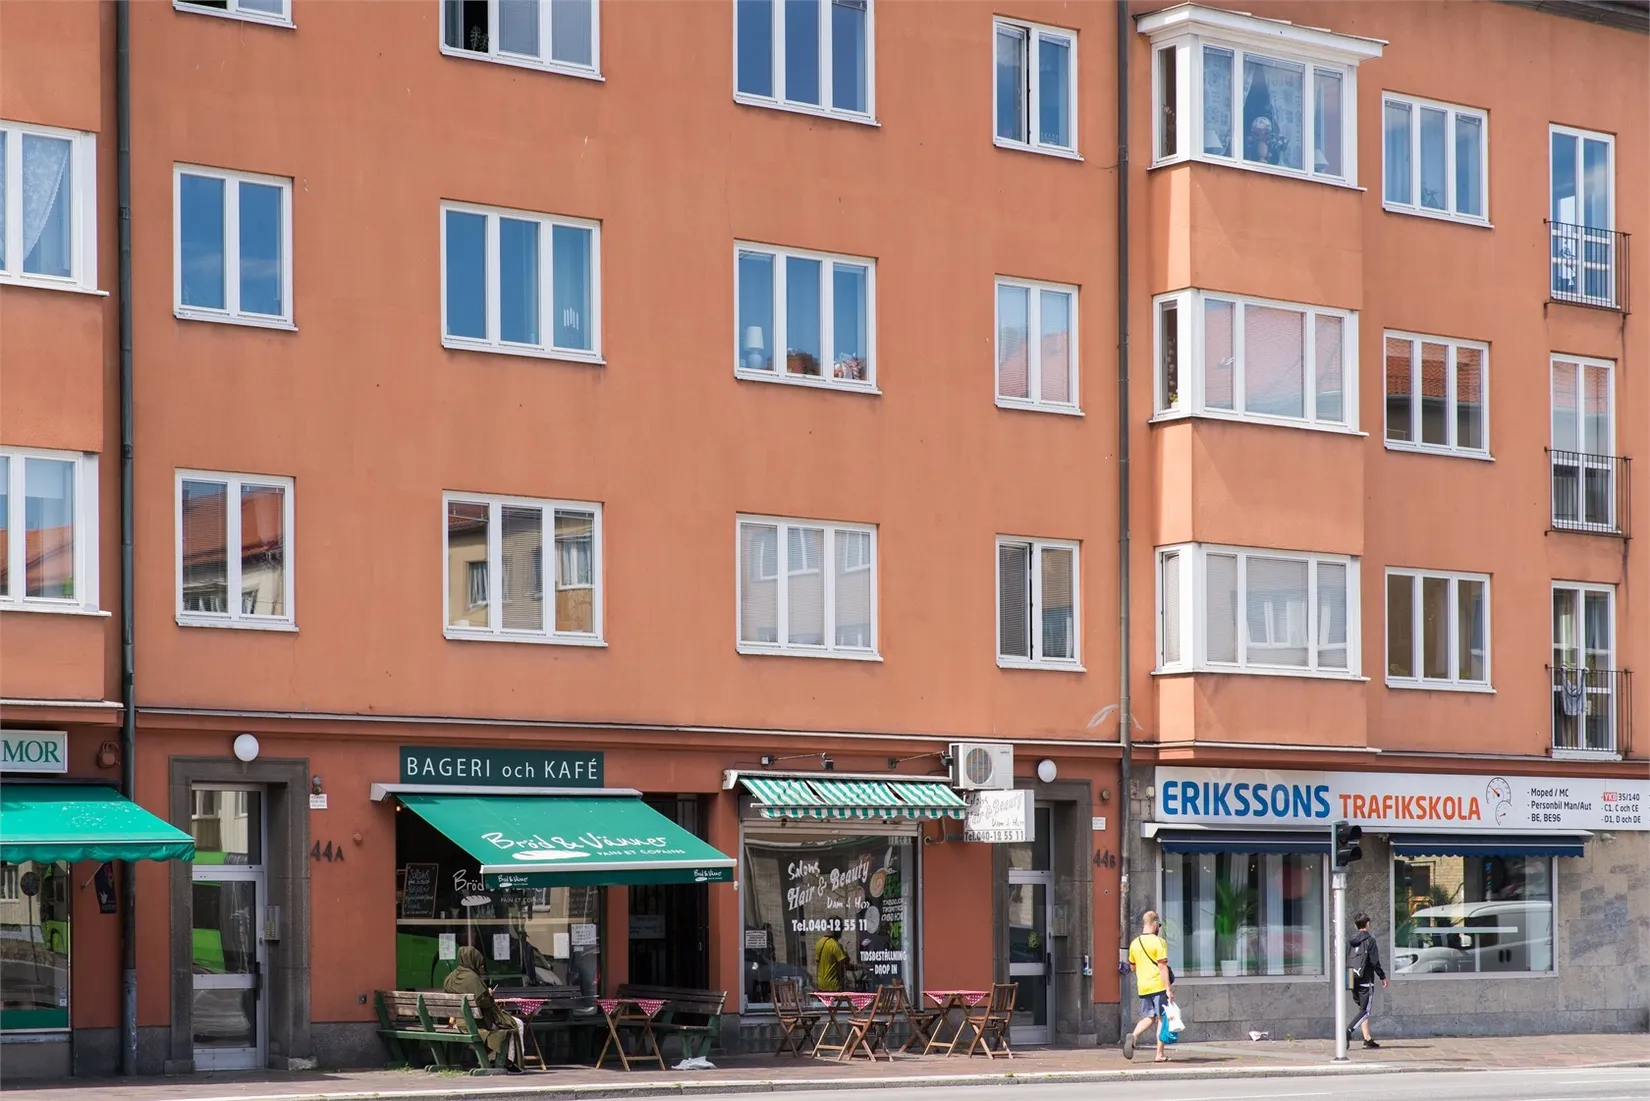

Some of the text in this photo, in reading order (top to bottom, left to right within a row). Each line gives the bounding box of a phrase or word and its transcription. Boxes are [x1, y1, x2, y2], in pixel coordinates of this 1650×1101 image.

[2, 740, 61, 763] MOR
[407, 757, 597, 780] BAGERI och KAFÉ
[1162, 780, 1482, 821] ERIKSSONS TRAFIKSKOLA
[1530, 788, 1553, 798] Moped
[1560, 789, 1569, 797] MC
[1618, 793, 1640, 801] 35/140
[993, 793, 1023, 815] Beauty
[1531, 801, 1591, 811] Personbil Man/Aut
[1620, 804, 1630, 812] och
[1632, 804, 1639, 812] CE
[1531, 813, 1561, 823] BE, BE96
[481, 832, 667, 849] Bröd & Vänner
[1004, 831, 1013, 840] 55
[310, 840, 344, 862] 44A
[1093, 849, 1115, 868] 44B
[453, 869, 484, 891] Bröd
[787, 883, 815, 911] Hair
[817, 876, 827, 897] &
[829, 860, 870, 891] Beauty
[791, 919, 868, 932] Tel.040-12 55 11
